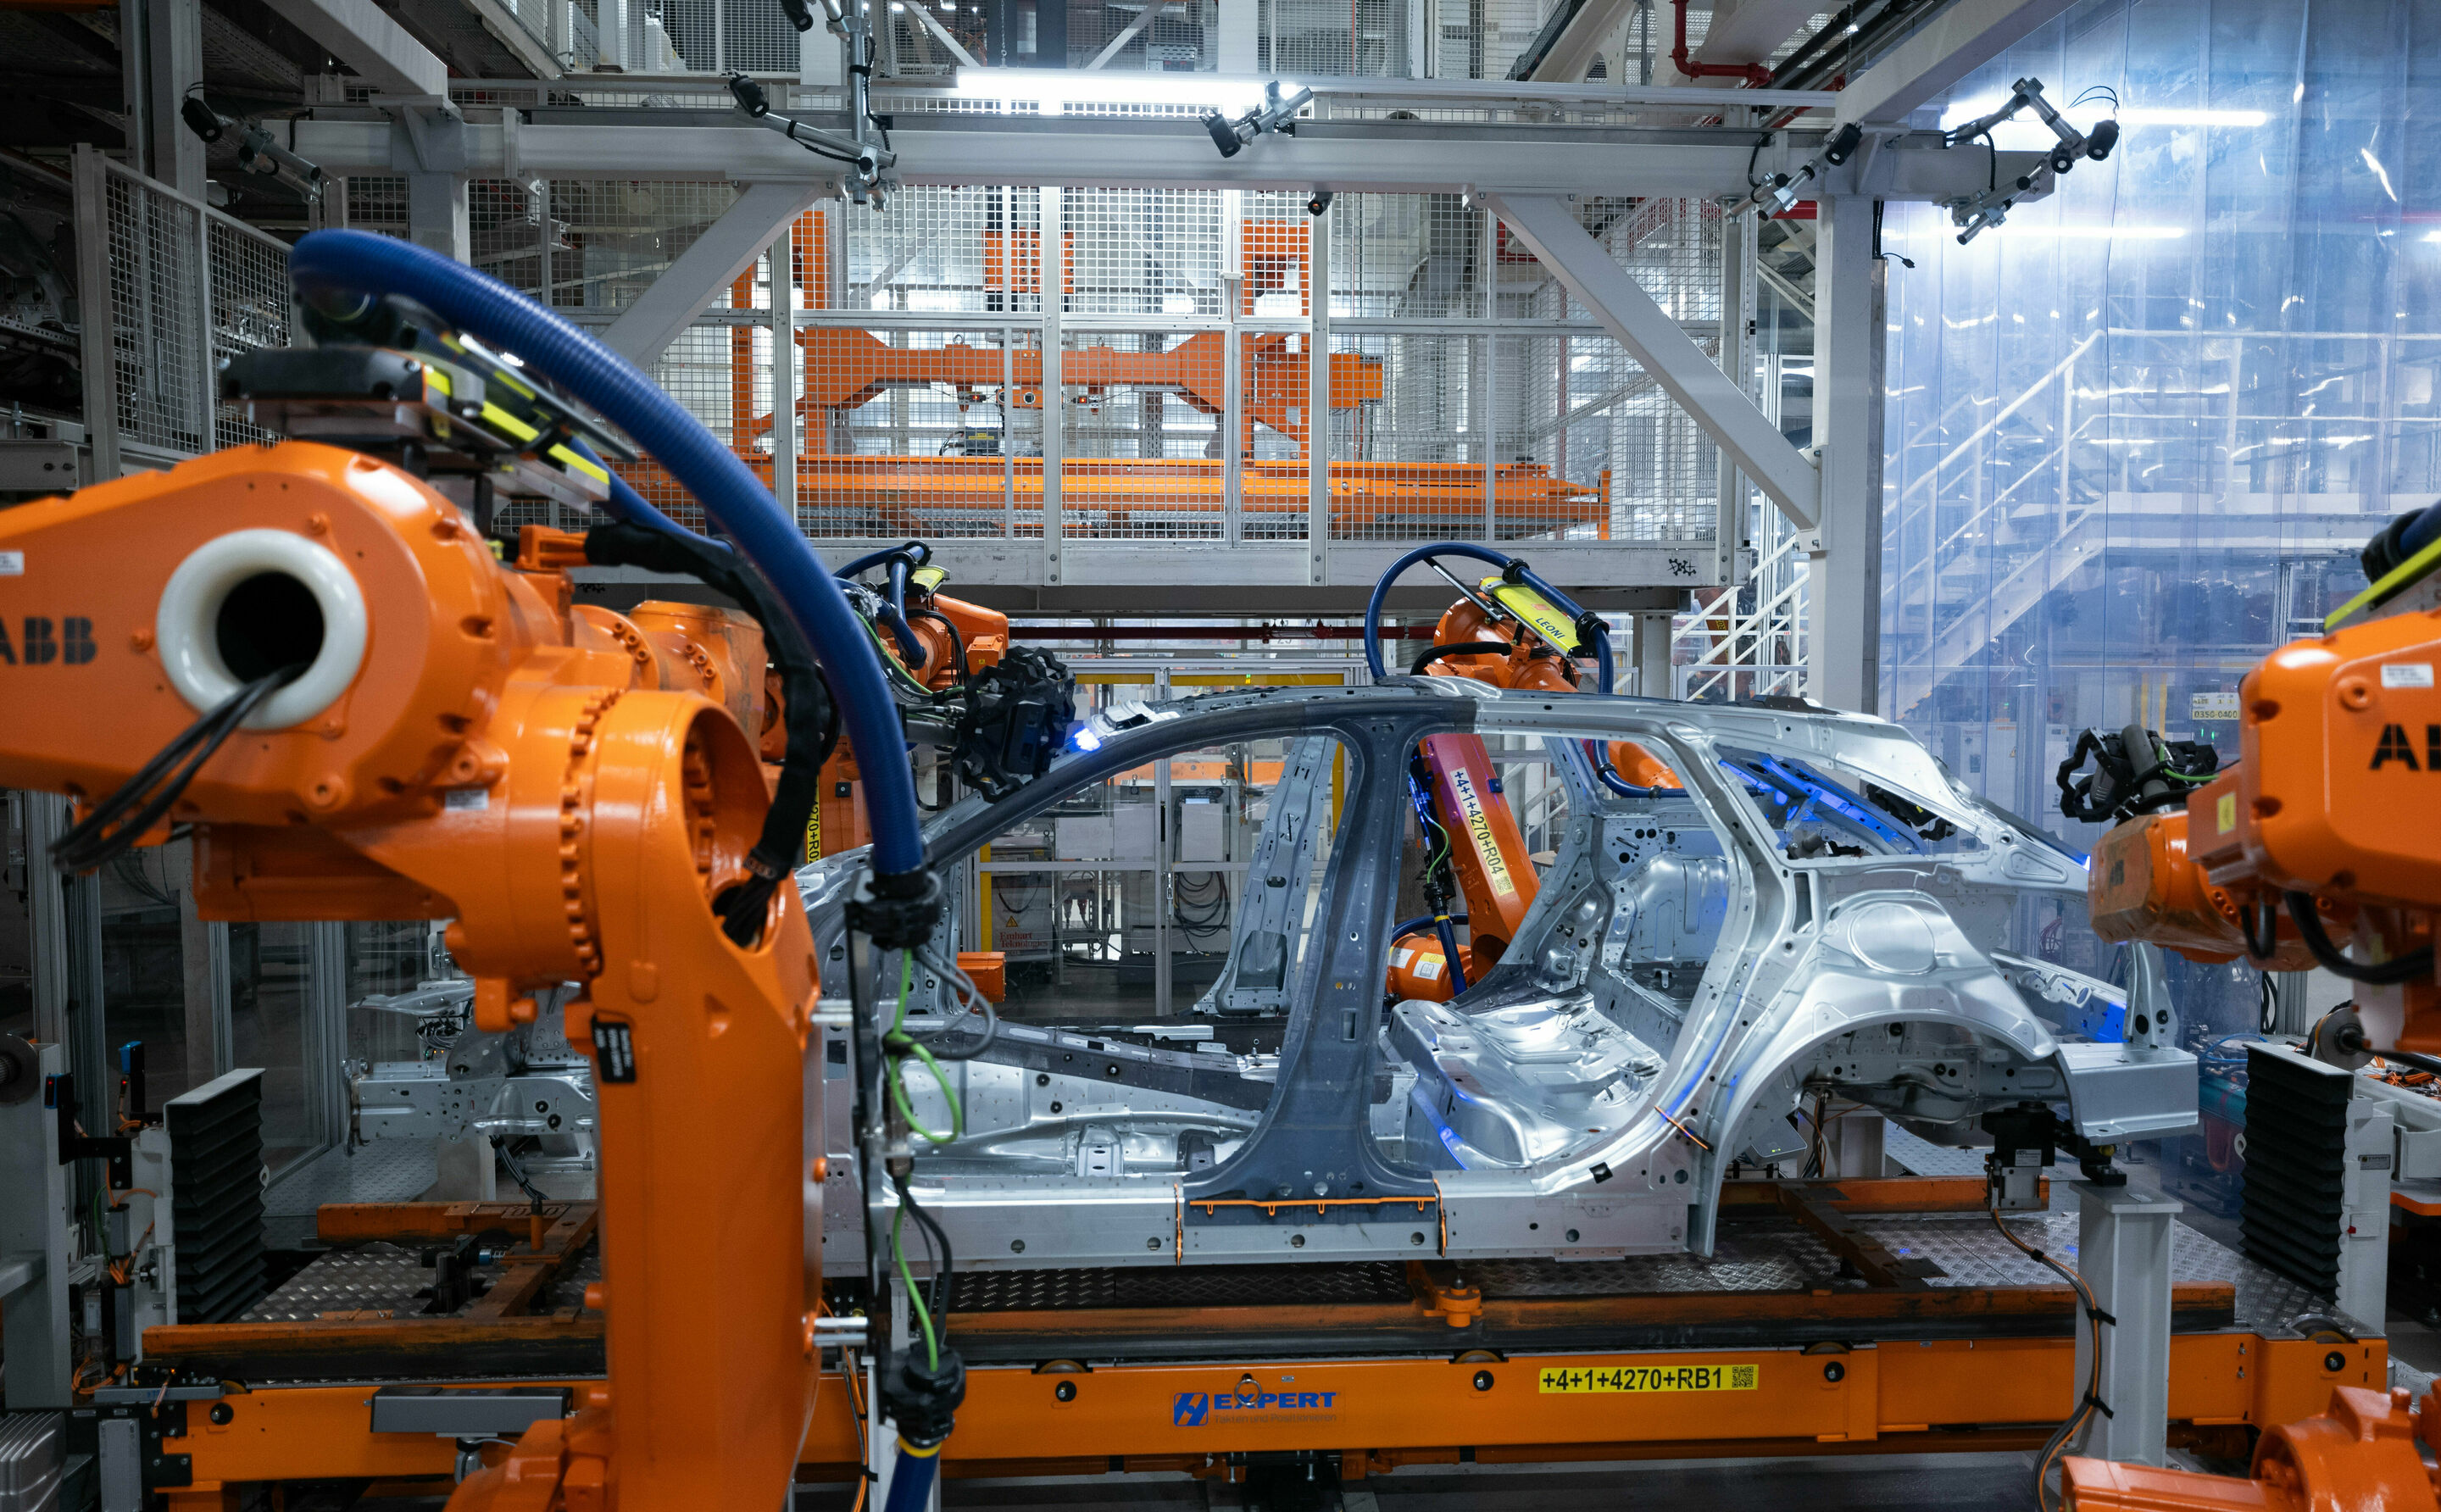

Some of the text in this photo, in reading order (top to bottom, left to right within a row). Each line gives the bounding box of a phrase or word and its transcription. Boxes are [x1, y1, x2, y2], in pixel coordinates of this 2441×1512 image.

[1535, 617, 1565, 639] LEONI
[1454, 771, 1505, 875] +4+1+4270+R04
[1543, 1368, 1721, 1390] +4+1+4270+RB1
[1214, 1392, 1337, 1409] EXPERT
